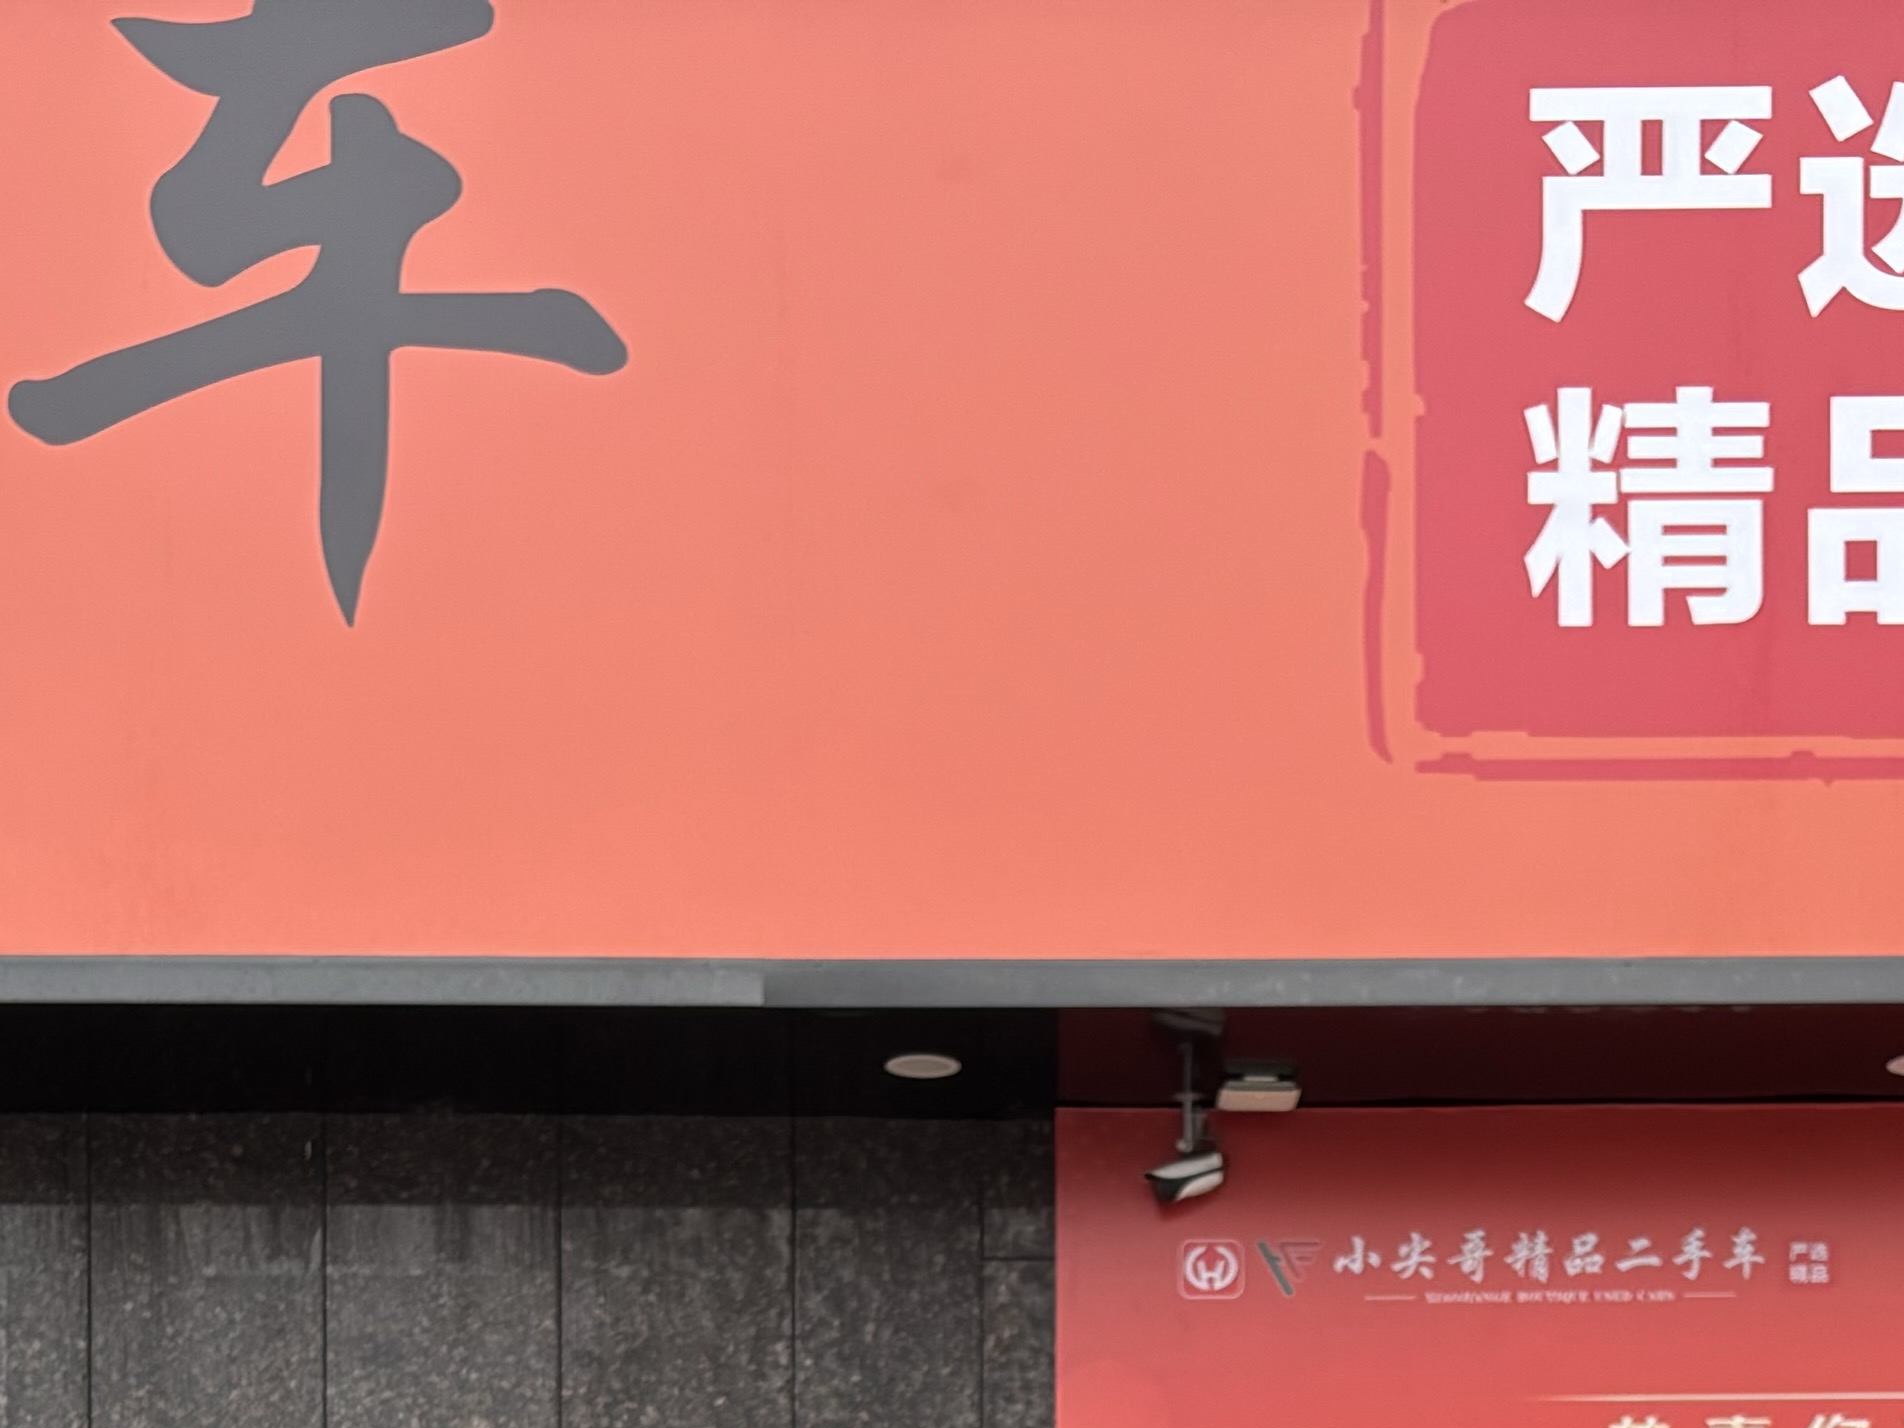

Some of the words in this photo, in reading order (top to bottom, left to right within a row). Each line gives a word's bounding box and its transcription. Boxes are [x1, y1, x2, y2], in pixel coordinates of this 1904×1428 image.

[1332, 1226, 1767, 1285] 小尖哥精品二手车
